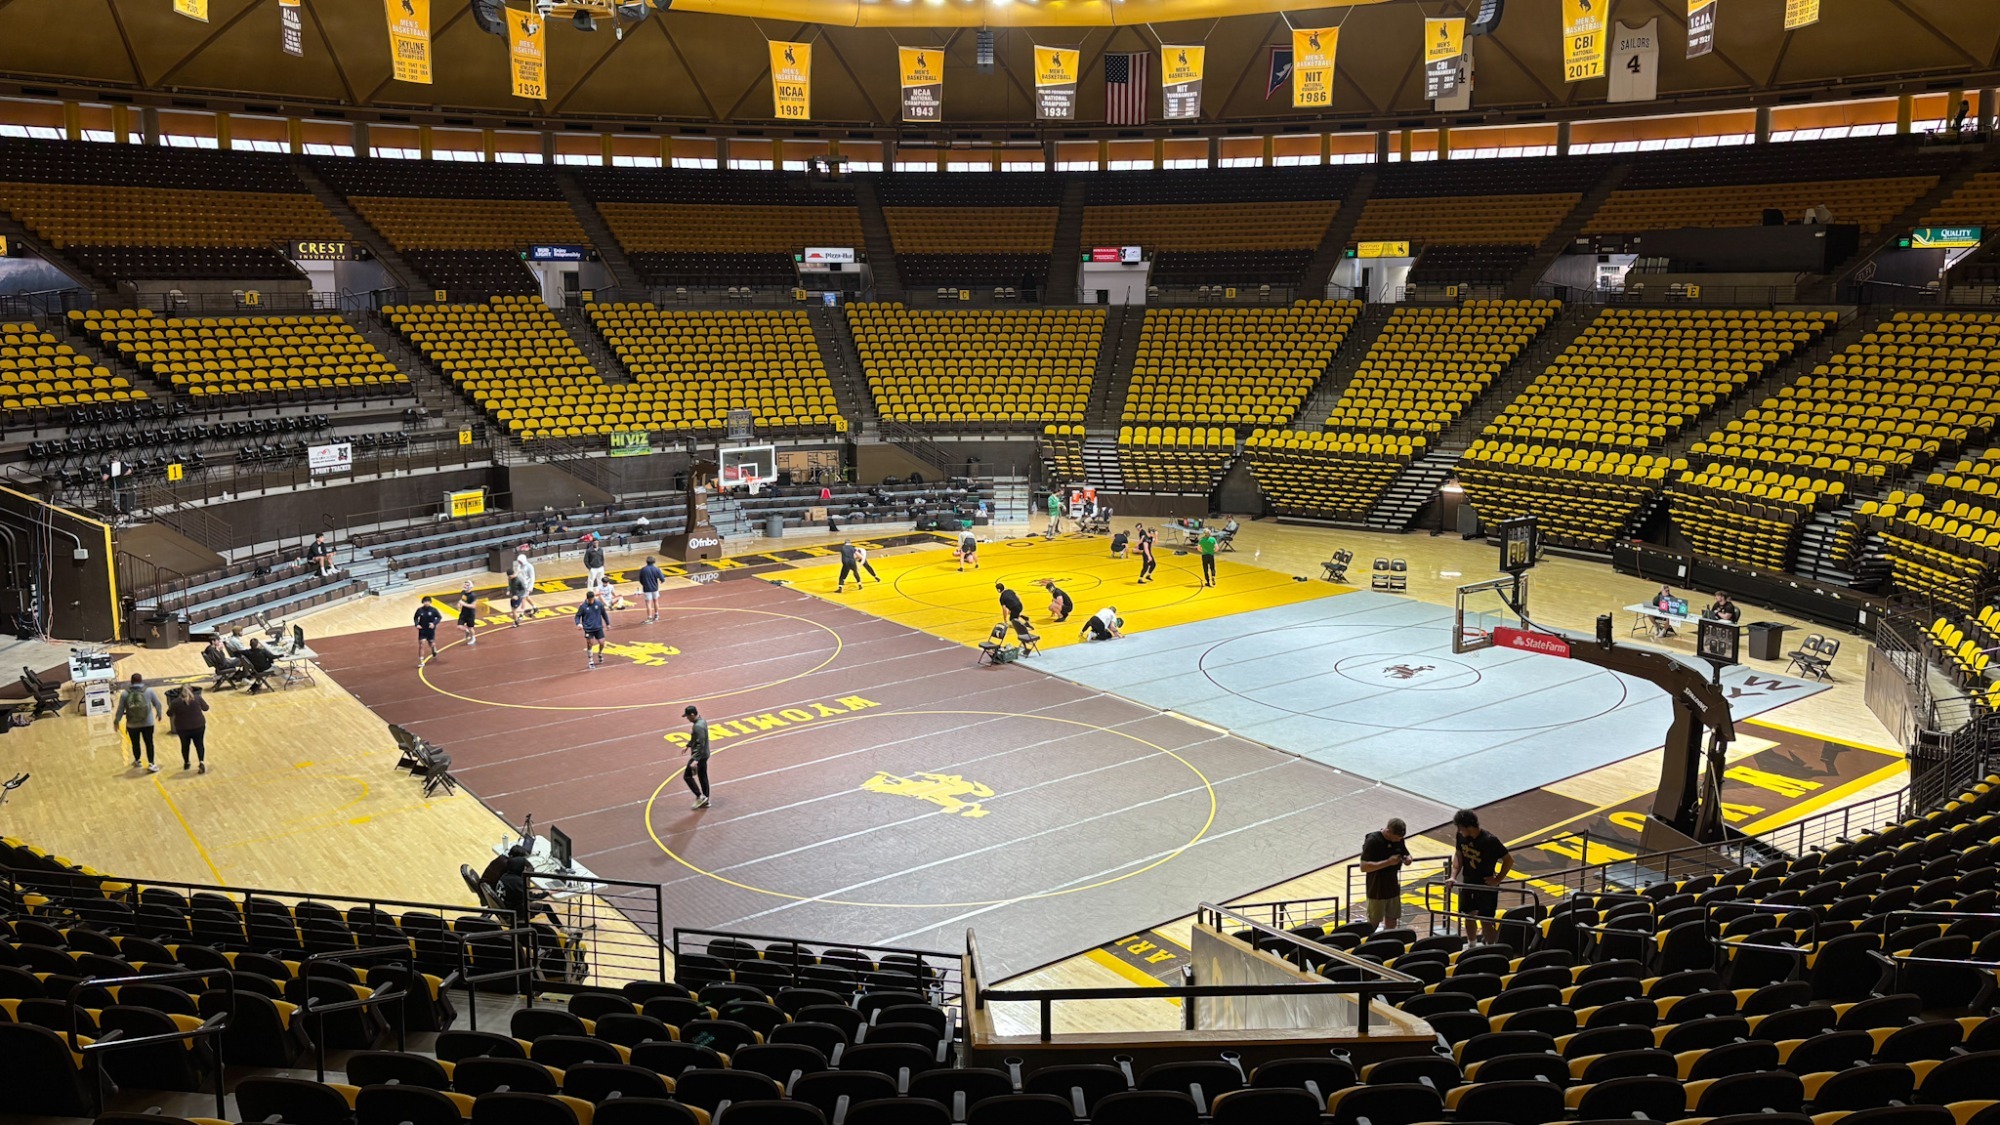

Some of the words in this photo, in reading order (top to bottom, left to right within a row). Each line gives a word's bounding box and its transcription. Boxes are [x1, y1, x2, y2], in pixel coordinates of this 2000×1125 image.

[1576, 16, 1595, 25] MEN'S
[392, 24, 428, 37] BASKETBALL
[1566, 22, 1602, 35] BASKETBALL
[398, 40, 424, 50] SKYLINE
[1575, 35, 1593, 49] CBI
[1620, 38, 1650, 51] SAILORS
[514, 46, 541, 56] BASKETBALL
[1430, 47, 1457, 55] BASKETBALL
[1573, 49, 1594, 57] NATIONAL
[398, 53, 425, 61] CHAMPIONS
[1304, 54, 1325, 62] MEN'S
[1566, 54, 1600, 64] CHAMPIONSHIP
[1297, 59, 1332, 68] BASKETBALL
[1436, 61, 1448, 70] CBI
[1627, 55, 1640, 73] 4
[1569, 62, 1598, 78] 2017
[775, 74, 806, 82] BASKETBALL
[1305, 71, 1322, 83] NIT
[518, 83, 541, 96] 1932
[780, 86, 803, 97] NCAA
[1177, 84, 1188, 92] NIT
[1300, 92, 1327, 103] 1986
[780, 105, 804, 116] 1987
[911, 107, 934, 117] 1943
[1044, 107, 1067, 117] 1934
[1940, 229, 1971, 237] QUALITY
[298, 242, 345, 254] CREST
[438, 291, 444, 299] B
[1449, 286, 1455, 295] D
[1690, 286, 1696, 297] E
[249, 292, 255, 303] A
[838, 421, 845, 431] 3
[462, 432, 469, 443] 2
[610, 433, 625, 447] HI
[625, 432, 649, 446] VIZ
[173, 466, 178, 478] 1
[454, 499, 482, 510] WYOMING
[699, 538, 718, 547] fnbo
[1525, 637, 1566, 653] StateFarm
[1683, 687, 1708, 712] SPALDING
[664, 694, 881, 749] WYOMING
